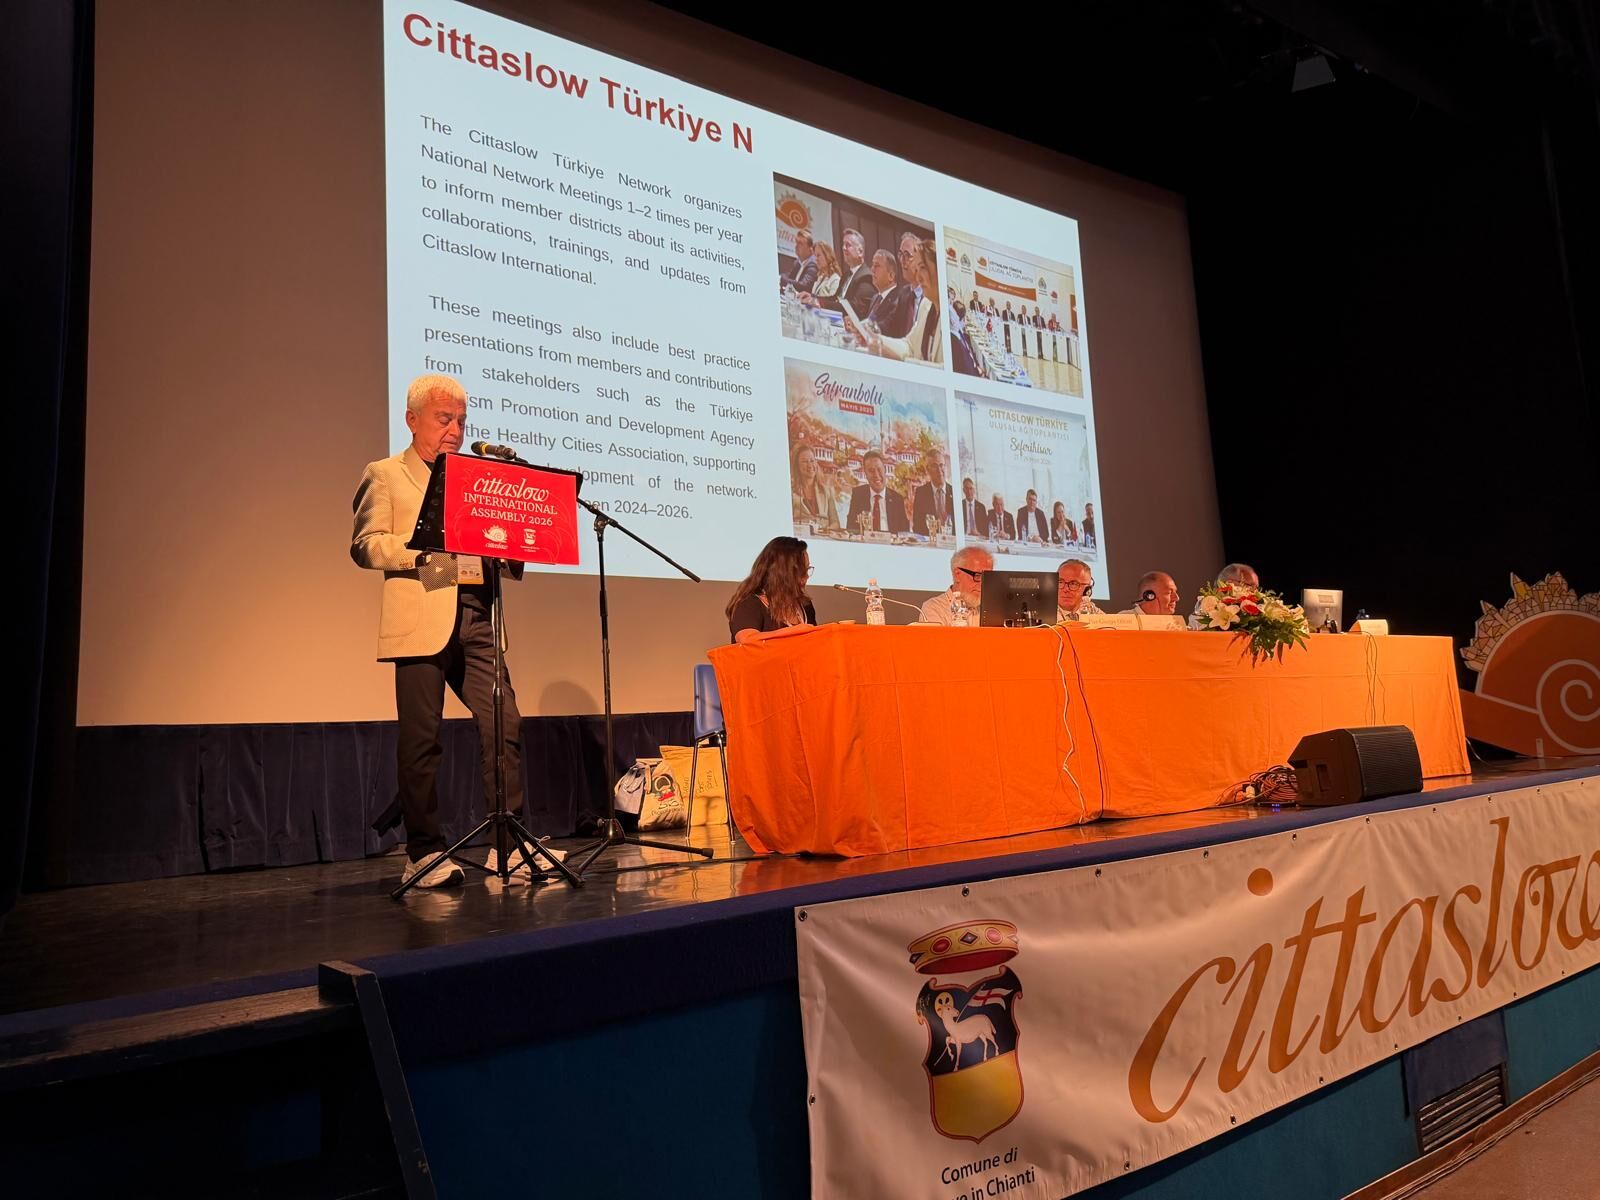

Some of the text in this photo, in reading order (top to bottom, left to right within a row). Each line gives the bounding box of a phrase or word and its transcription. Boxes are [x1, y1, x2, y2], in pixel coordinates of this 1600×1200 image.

[403, 13, 753, 154] Cittaslow Türkiye N
[420, 114, 742, 219] The Cittaslow Türkiye Network organizes
[421, 144, 743, 244] National Network Meetings 1–2 times per year
[421, 174, 745, 271] to inform member districts about its activities,
[422, 205, 746, 294] collaborations, trainings, and updates from
[422, 234, 596, 286] Cittaslow International.
[429, 295, 751, 371] These meetings also include best practice
[424, 326, 752, 396] presentations from members and contributions
[424, 355, 753, 424] from stakeholders such as the Türkiye
[814, 372, 884, 406] Safranbolu
[501, 398, 579, 423] Promotion
[586, 411, 612, 427] and
[619, 416, 705, 442] Development
[710, 430, 755, 450] Agency
[988, 408, 1034, 424] CITTASLOW
[464, 423, 756, 475] the Healthy Cities Association, supporting
[463, 492, 558, 515] INTERNATIONAL
[473, 472, 549, 502] cittaslow
[614, 499, 693, 520] 2024–2026.
[648, 474, 661, 489] of
[674, 477, 694, 492] the
[706, 482, 758, 499] network.
[470, 507, 553, 526] ASSEMBLY 2026
[941, 1146, 1018, 1184] Comune di
[986, 1166, 1036, 1197] Chianti
